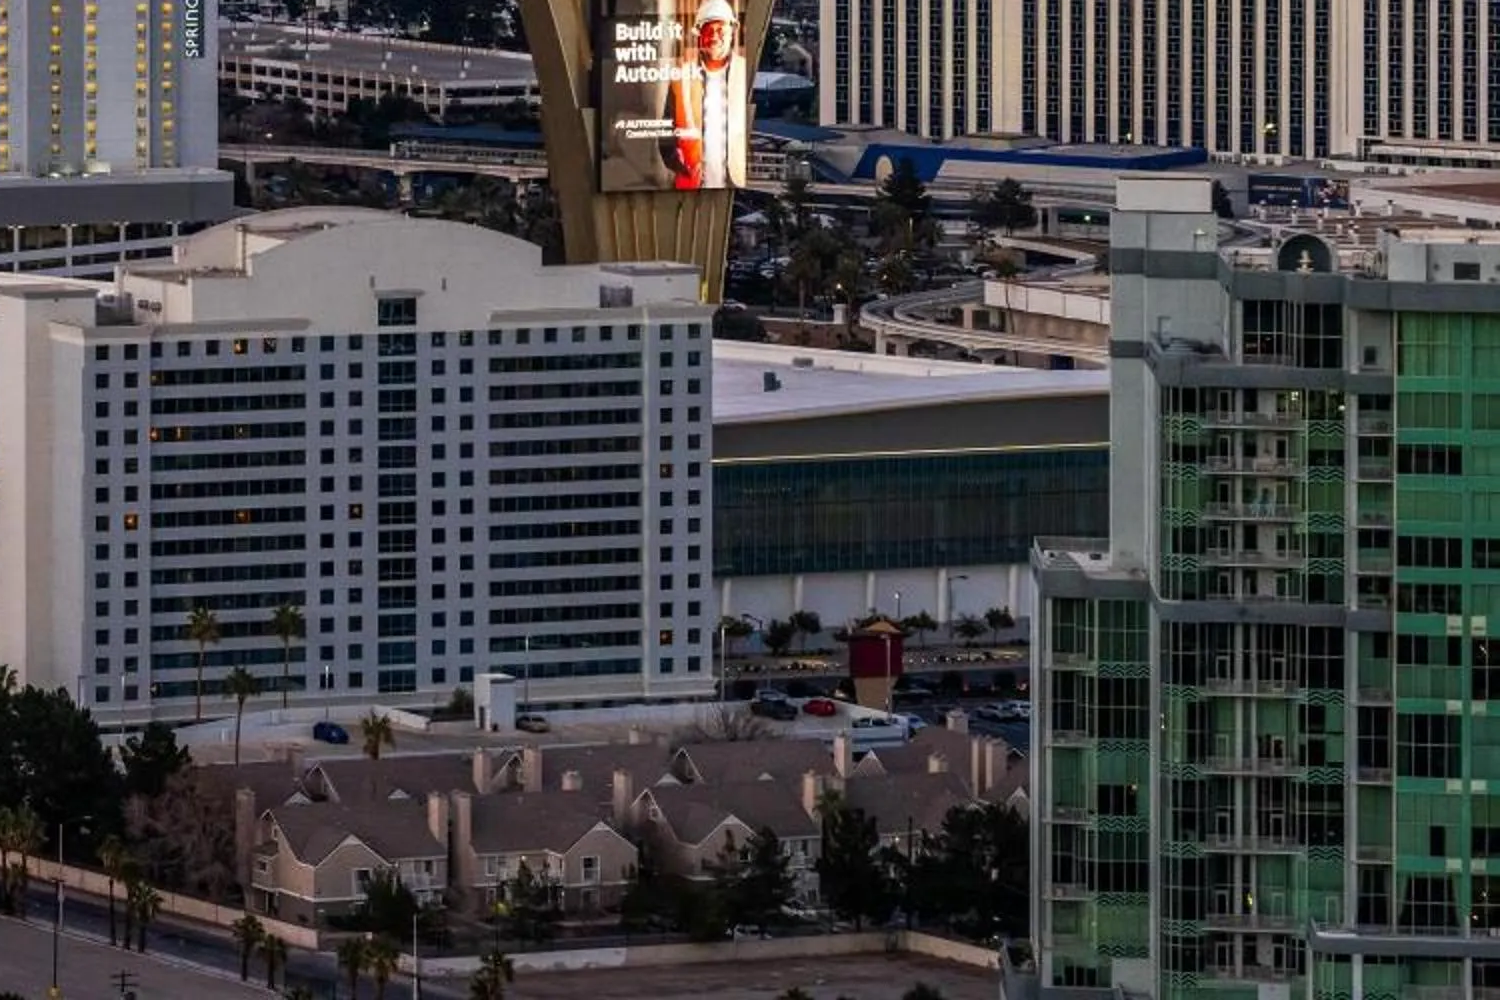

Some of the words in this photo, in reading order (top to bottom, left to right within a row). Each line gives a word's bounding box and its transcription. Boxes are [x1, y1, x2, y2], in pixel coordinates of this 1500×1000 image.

[615, 21, 662, 41] Build
[669, 21, 683, 39] it
[615, 41, 657, 62] with
